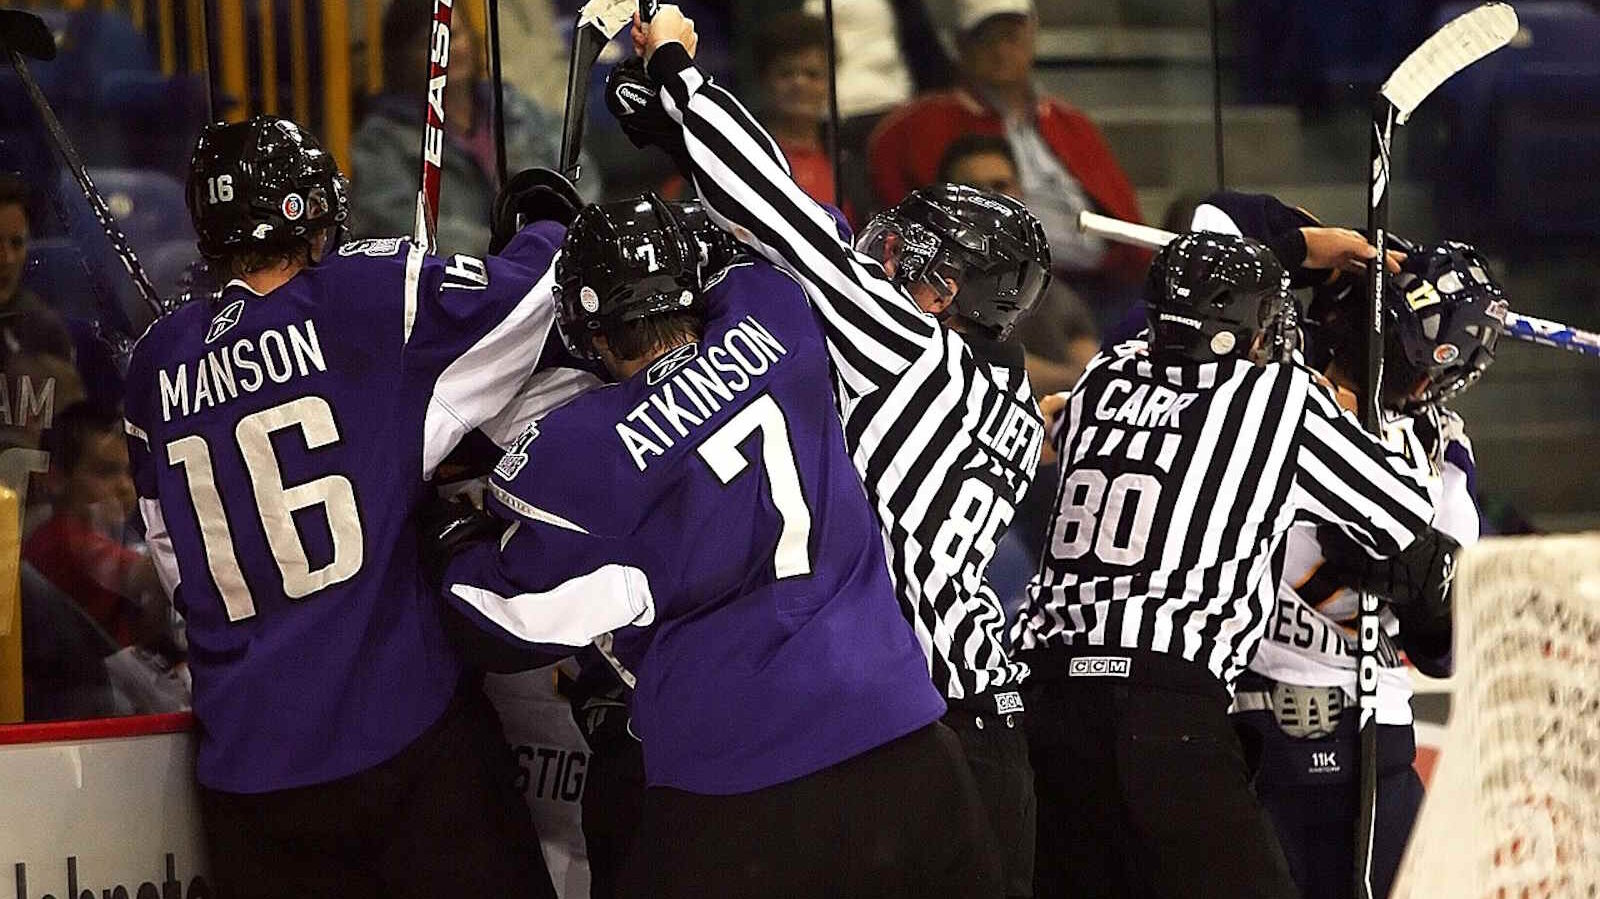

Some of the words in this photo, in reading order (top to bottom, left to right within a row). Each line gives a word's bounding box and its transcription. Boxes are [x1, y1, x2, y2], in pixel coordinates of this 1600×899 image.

[620, 87, 647, 107] Reebok
[208, 174, 234, 204] 16
[636, 243, 660, 273] 7
[159, 319, 327, 422] MANSON
[615, 315, 788, 472] ATKINSON
[1095, 378, 1199, 428] CARR
[166, 396, 364, 622] 16
[697, 394, 812, 580] 7
[1050, 469, 1162, 567] 80
[929, 477, 1016, 597] 85
[1071, 659, 1129, 676] CCM
[1311, 752, 1337, 767] 11K
